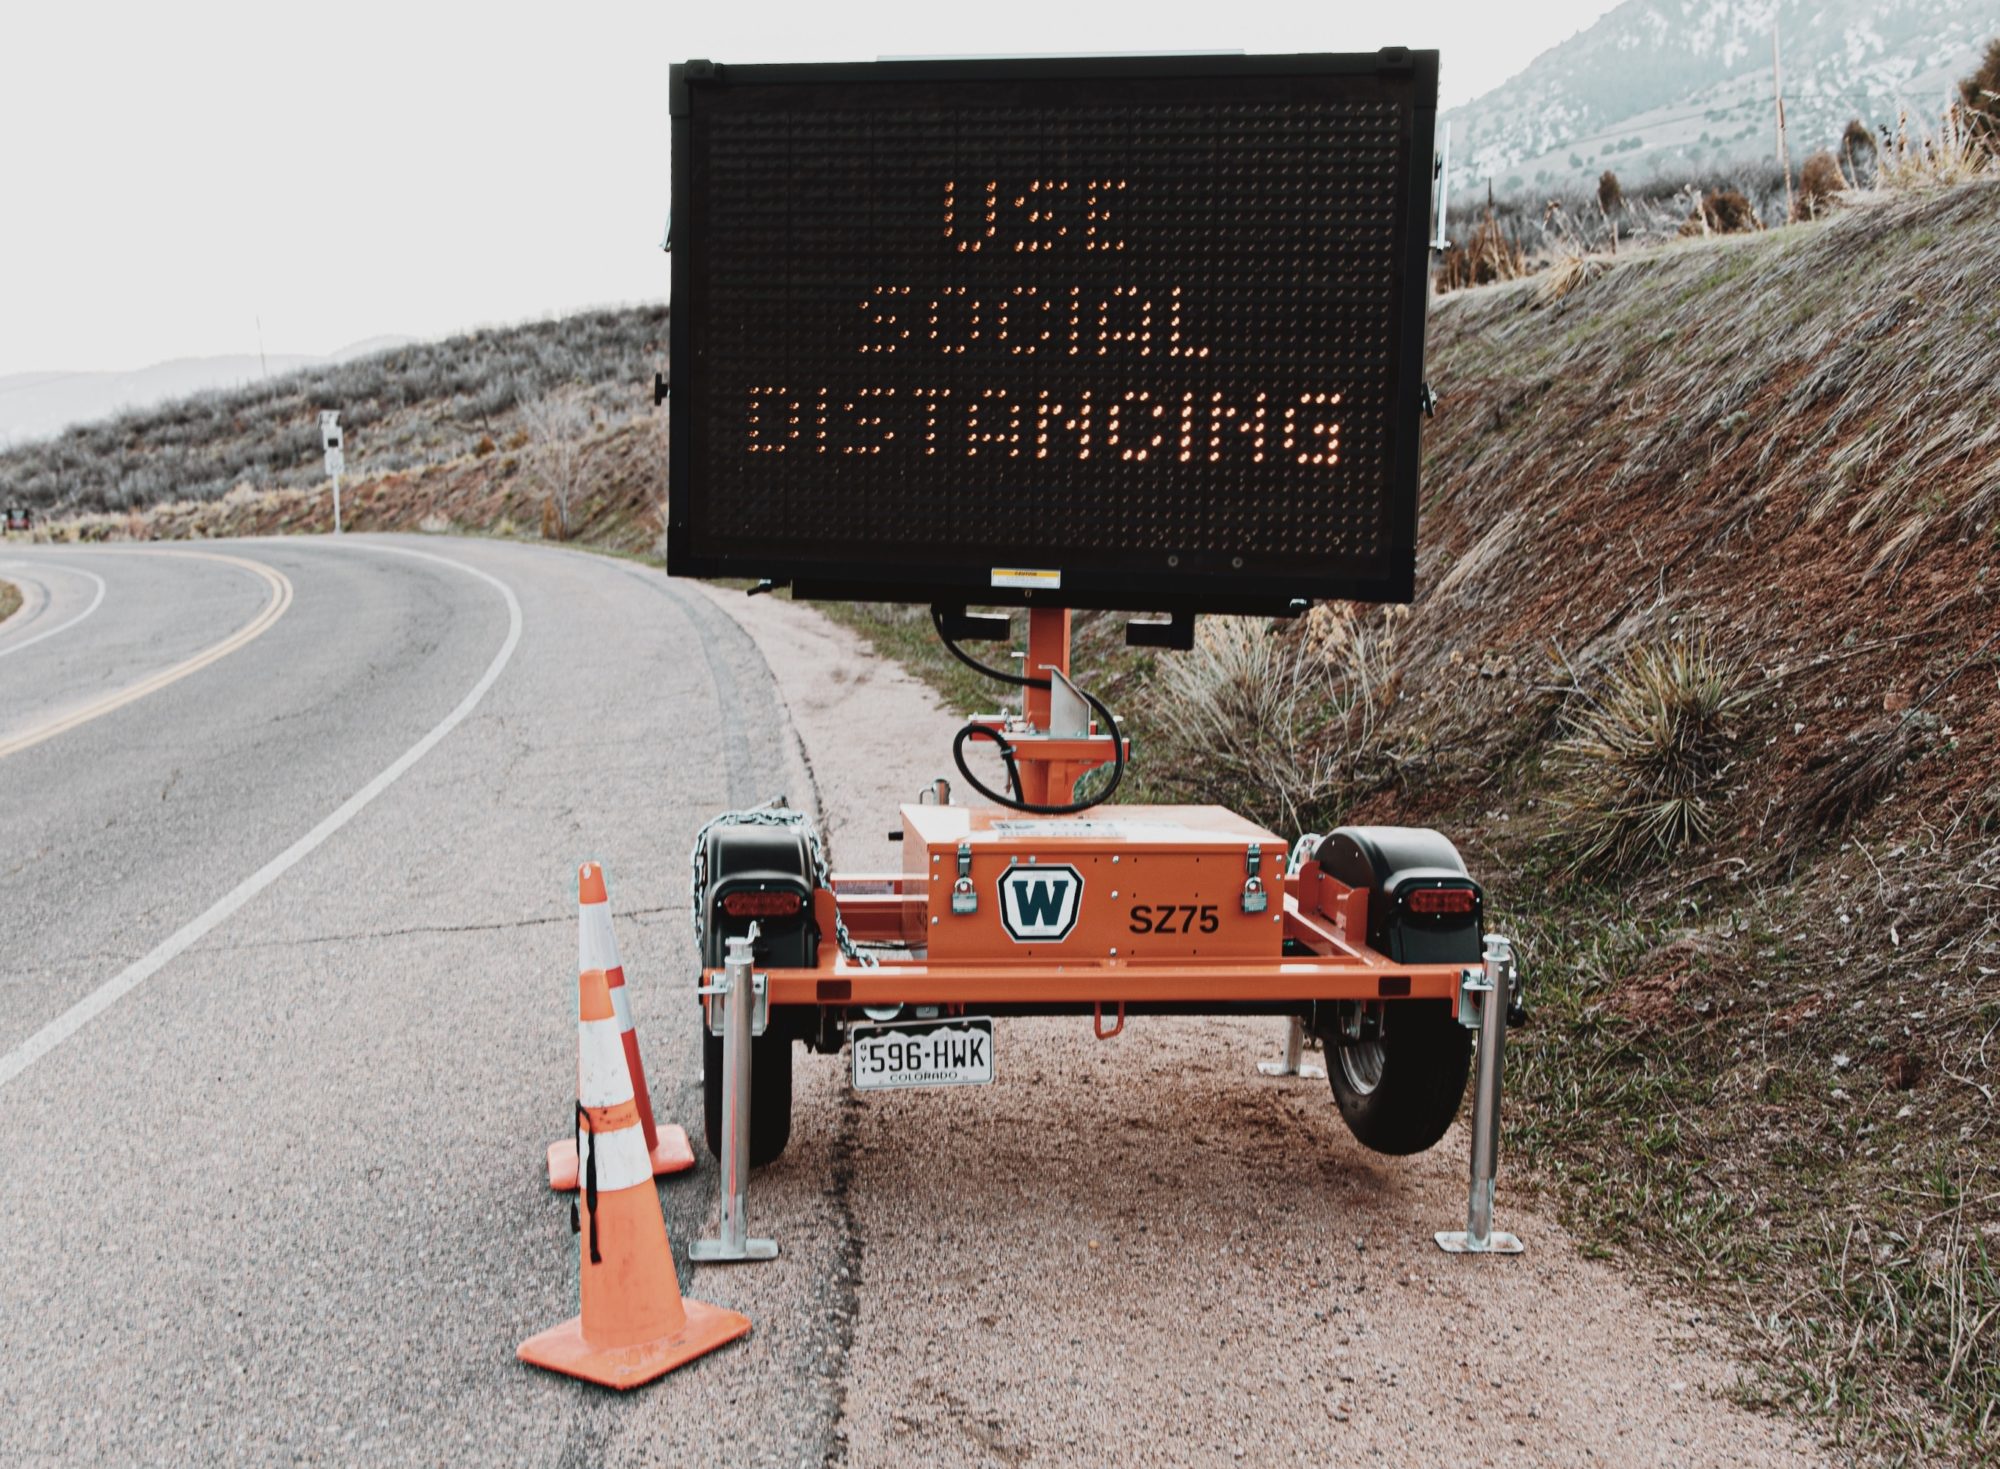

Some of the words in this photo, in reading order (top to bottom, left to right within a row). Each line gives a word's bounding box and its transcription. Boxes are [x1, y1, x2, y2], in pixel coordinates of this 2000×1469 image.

[943, 180, 1127, 253] USE
[859, 285, 1209, 359] SOCIAL
[748, 386, 1342, 465] DISTANCING
[1012, 880, 1069, 926] W
[1129, 905, 1219, 934] SZ75
[890, 1071, 958, 1082] COLORADO
